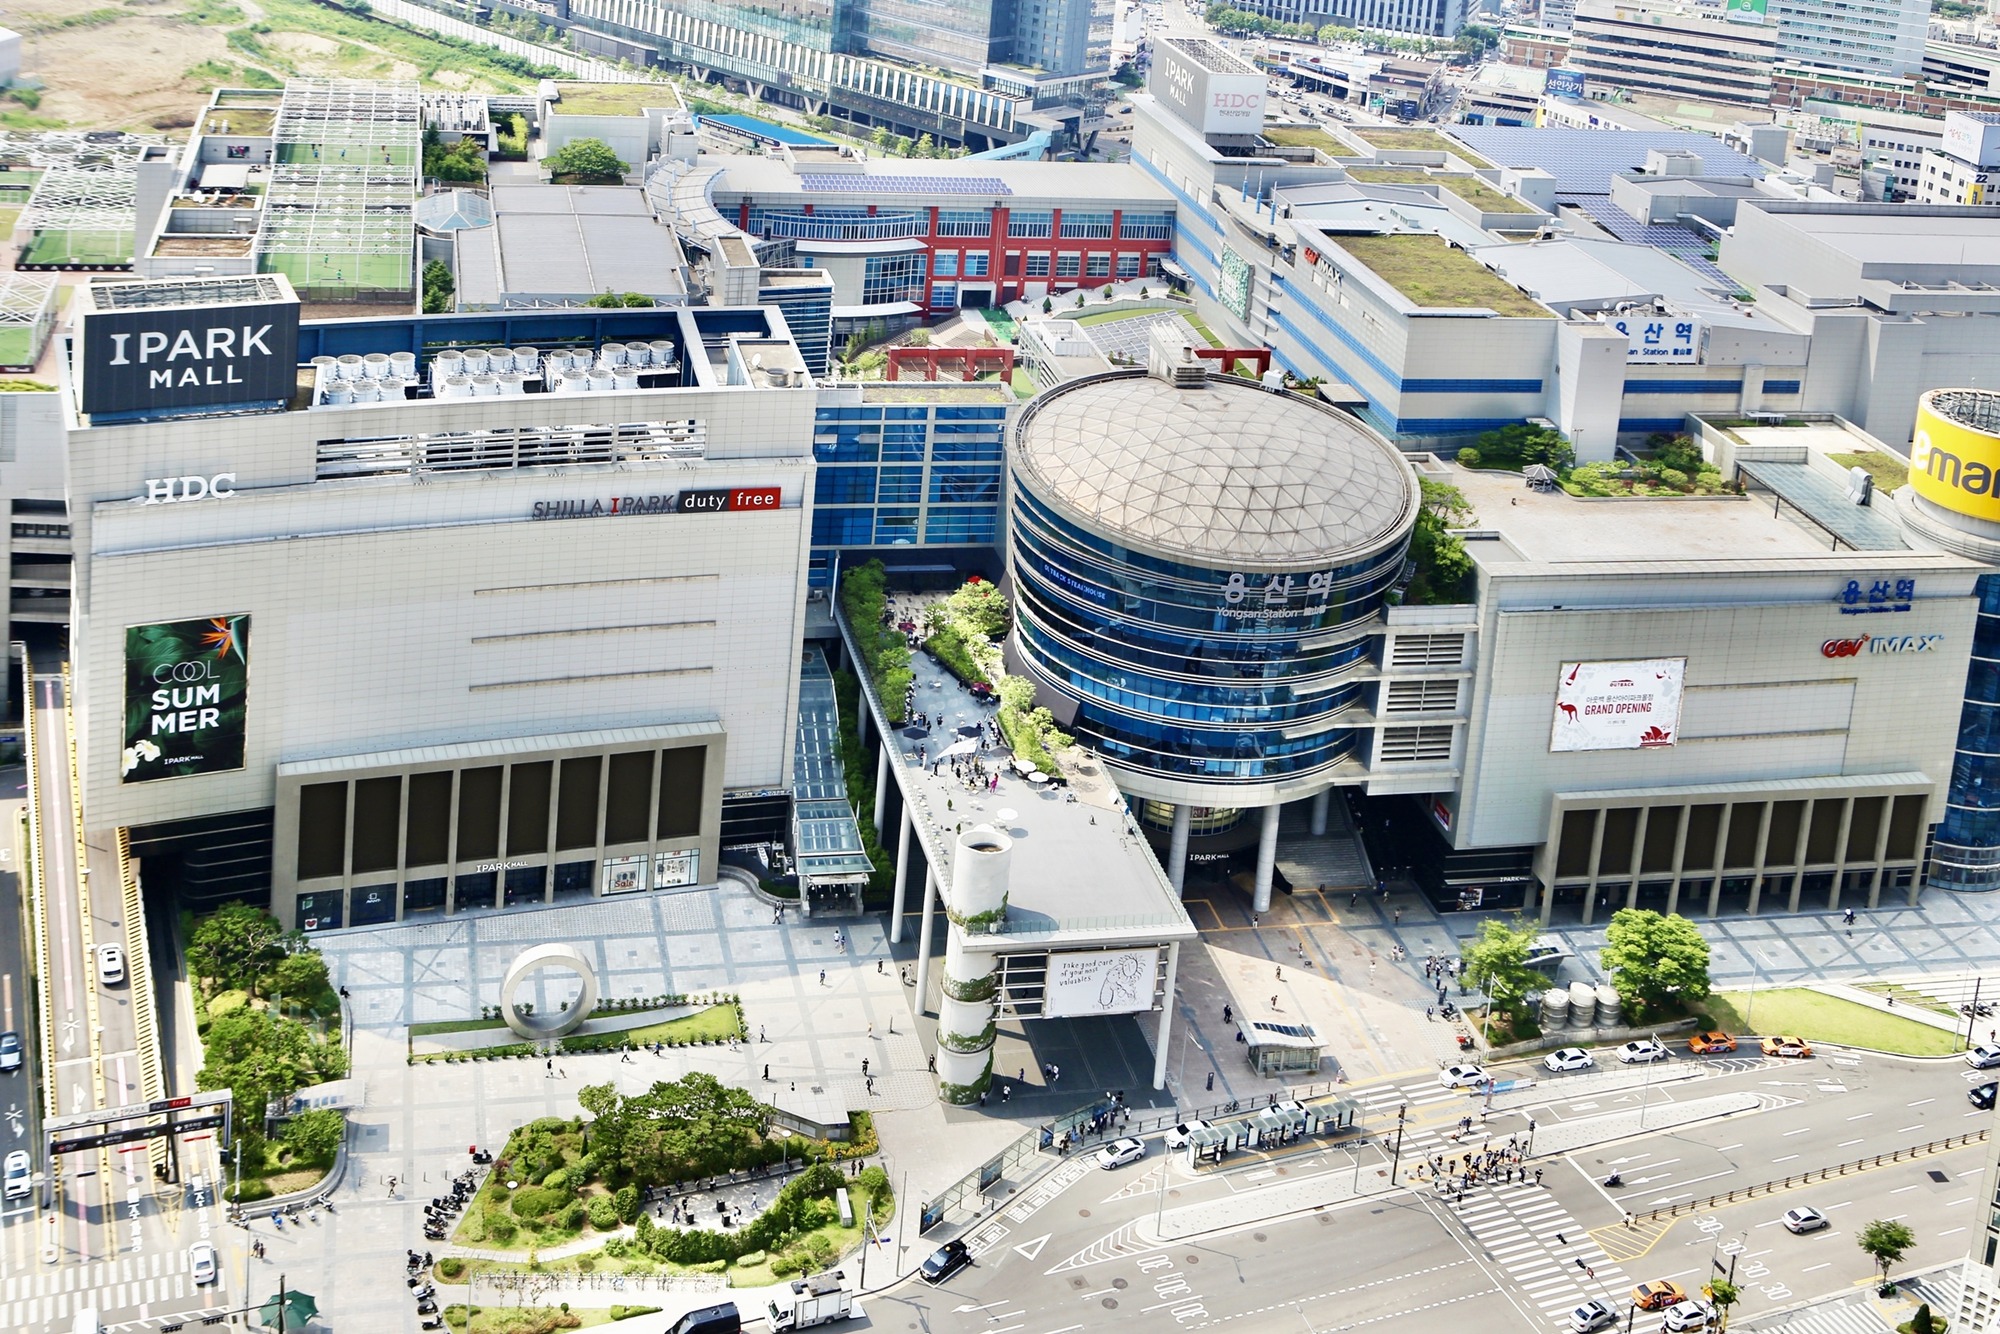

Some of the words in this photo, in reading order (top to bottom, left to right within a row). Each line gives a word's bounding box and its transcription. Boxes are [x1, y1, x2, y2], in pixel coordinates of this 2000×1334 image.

[1164, 57, 1195, 95] IPARK
[1547, 79, 1583, 93] 선인상가
[1169, 84, 1187, 107] MALL
[1213, 93, 1259, 108] HDC
[1975, 174, 1989, 183] 22
[1318, 257, 1344, 287] IMAX
[109, 324, 273, 366] IPARK
[1642, 347, 1669, 356] Station
[149, 365, 243, 389] MALL
[145, 472, 236, 505] HDC
[533, 497, 604, 518] SHILLA
[610, 494, 675, 514] IPARK
[684, 494, 726, 510] duty
[736, 492, 774, 506] free
[1221, 571, 1334, 604] 용산역
[1842, 579, 1915, 604] 용산역
[1216, 606, 1262, 620] Yongsan
[1263, 607, 1298, 618] Station
[1822, 638, 1864, 658] CGV
[1871, 635, 1937, 654] IMAX
[153, 660, 220, 684] COOL
[151, 683, 220, 711] SUM
[1586, 695, 1605, 704] 아웃백
[1584, 703, 1614, 716] GRAND
[1615, 702, 1652, 714] OPENING
[151, 707, 220, 735] MER
[164, 756, 190, 765] IPARK
[476, 861, 511, 873] IPARK
[511, 860, 528, 868] MALL
[614, 879, 634, 888] Sale
[1060, 969, 1068, 977] of
[1070, 969, 1083, 978] your
[1081, 959, 1097, 969] good
[1960, 1069, 1989, 1083] 30
[172, 1099, 189, 1107] free
[1693, 1215, 1725, 1234] 30
[1716, 1237, 1748, 1257] 30
[1136, 1254, 1174, 1274] 30
[1738, 1260, 1771, 1279] 30
[1153, 1279, 1192, 1300] 30
[1760, 1281, 1793, 1301] 30
[1170, 1302, 1209, 1324] 30
